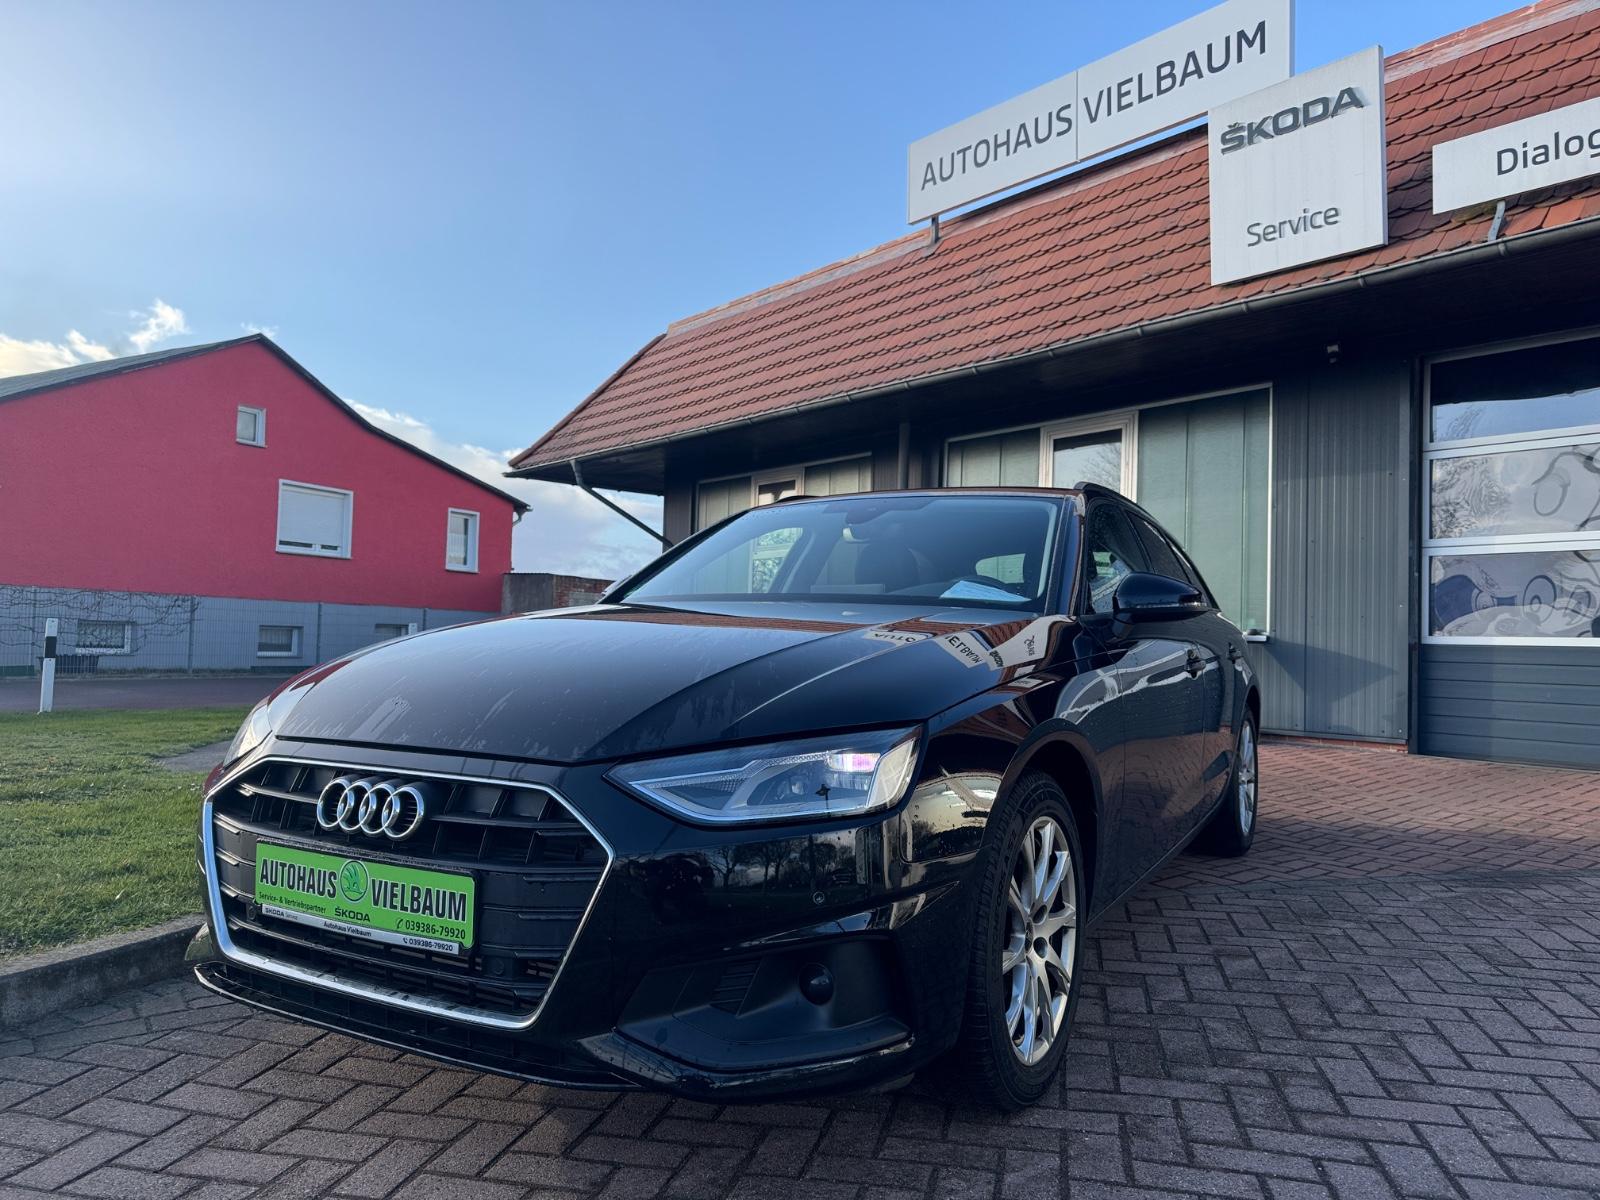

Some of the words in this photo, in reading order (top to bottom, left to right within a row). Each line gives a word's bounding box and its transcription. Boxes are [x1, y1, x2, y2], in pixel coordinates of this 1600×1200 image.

[920, 103, 1073, 191] AUTOHAUS
[1083, 20, 1266, 125] VIELBAUM
[1220, 86, 1364, 155] ŠKODA
[1246, 206, 1341, 248] Service
[260, 858, 338, 899] AUTOHAUS
[371, 878, 467, 922] VIELBAUM
[334, 906, 371, 922] ŠKODA
[405, 919, 466, 940] 039386-79920
